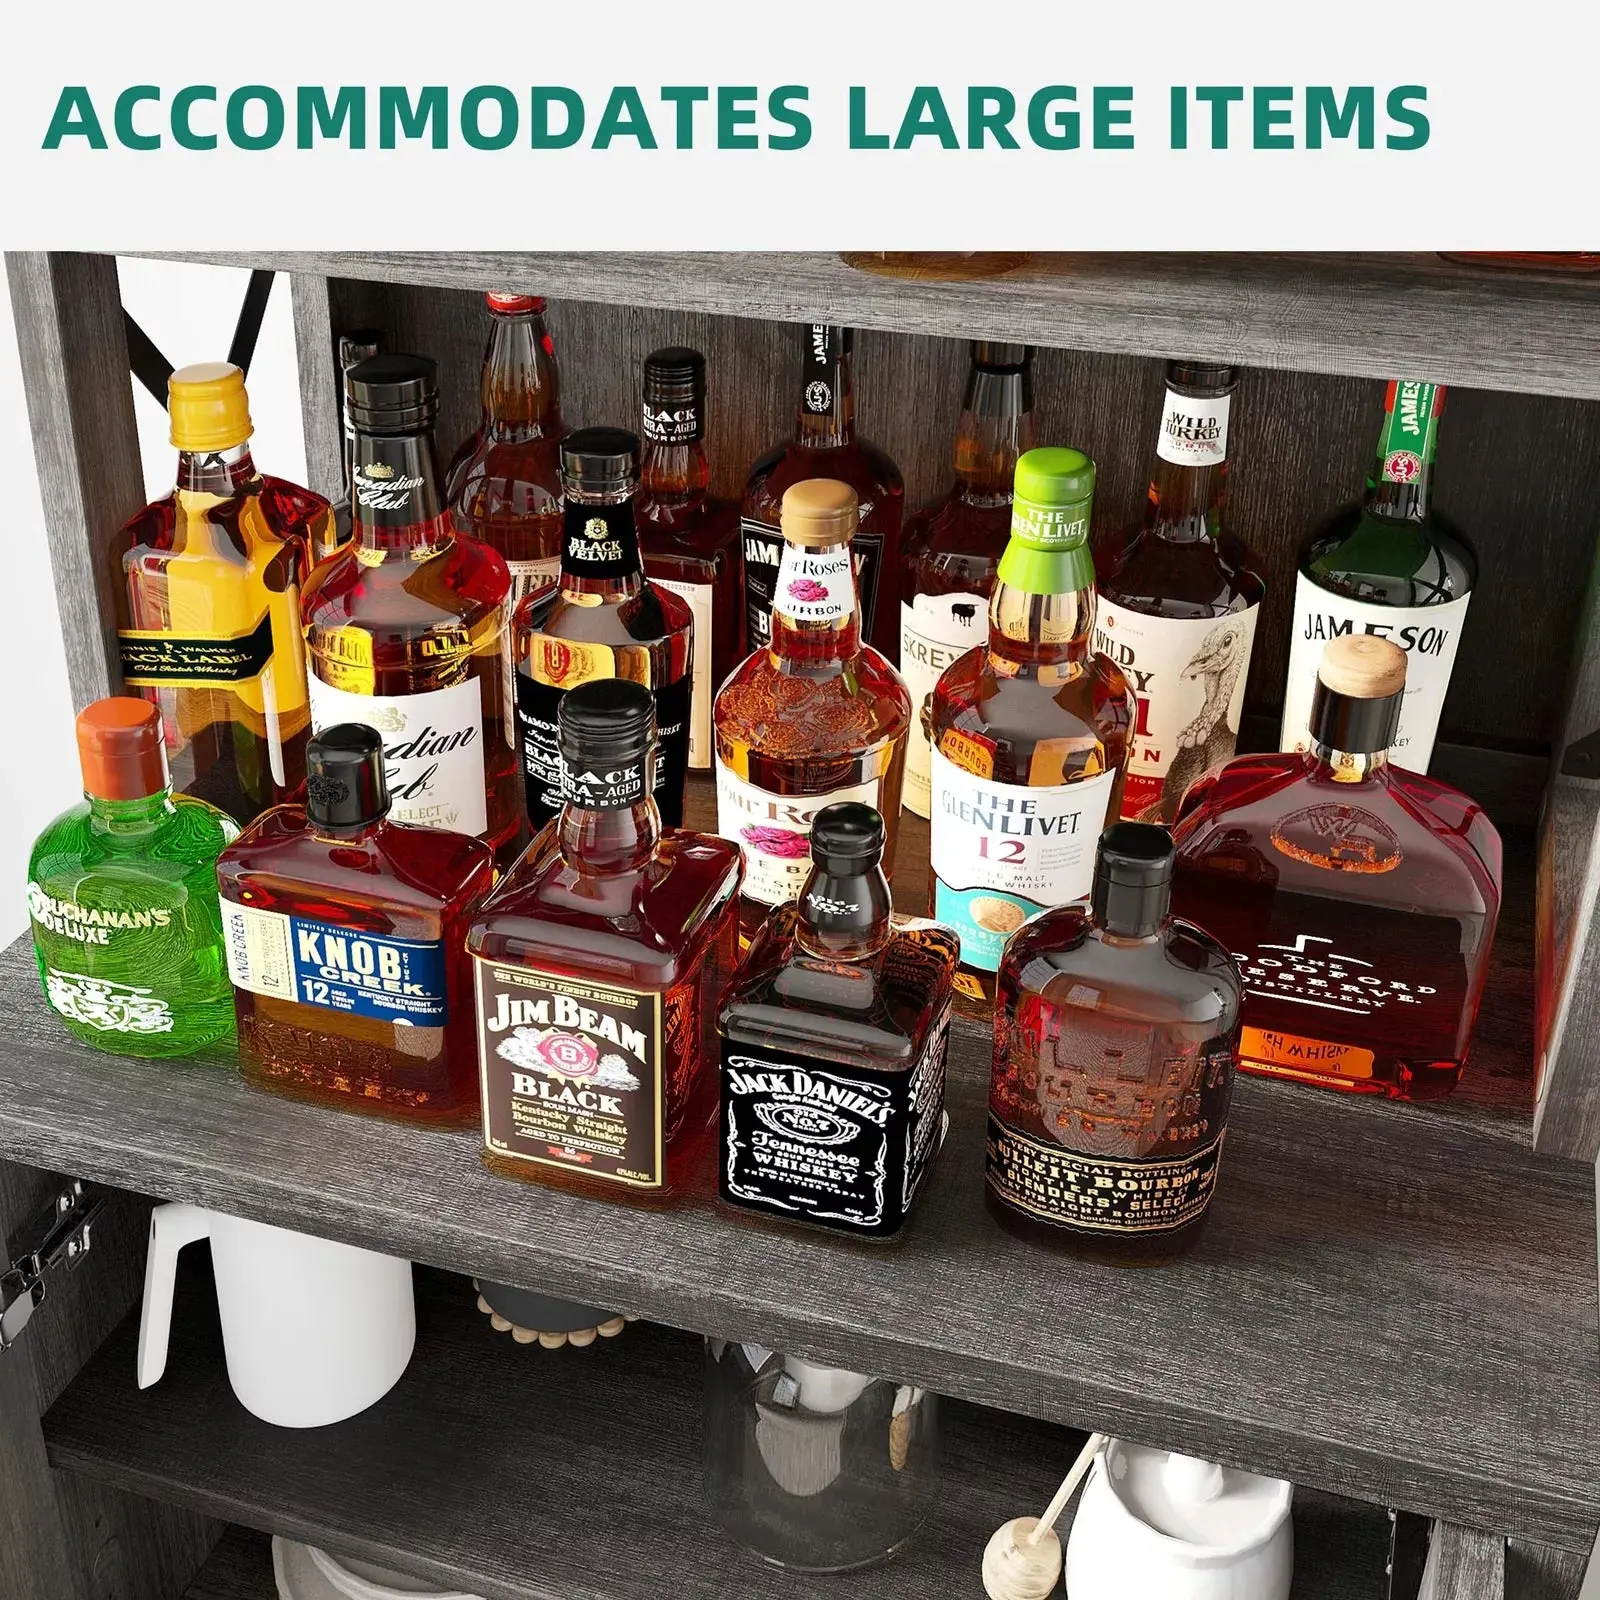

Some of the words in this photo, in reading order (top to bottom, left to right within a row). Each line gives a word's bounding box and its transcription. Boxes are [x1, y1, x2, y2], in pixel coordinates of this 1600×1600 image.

[643, 402, 696, 422] LACK
[1172, 411, 1217, 428] WILD
[1165, 418, 1222, 440] TURKEY
[1028, 507, 1065, 523] THE
[568, 546, 623, 561] VELVET
[571, 537, 621, 551] BLACK
[803, 558, 849, 577] Roses
[179, 653, 252, 664] LABEL
[1095, 627, 1136, 666] WILD
[560, 760, 641, 785] LACK
[605, 778, 641, 798] AGED
[942, 790, 1082, 836] GLENLIVET
[973, 788, 1037, 815] THE
[979, 836, 1026, 865] 12
[44, 912, 110, 945] DELUXE
[298, 929, 402, 980] KNOB
[1283, 953, 1343, 971] THE
[262, 974, 279, 988] 12
[302, 980, 330, 1005] 12
[319, 966, 428, 997] CREEK
[358, 990, 394, 1003] KENTUCKY
[396, 997, 432, 1008] STRAIGHT
[407, 1006, 443, 1014] WHISKEY
[488, 994, 550, 1032] JIM
[552, 994, 648, 1064] BEAM
[511, 1072, 625, 1116] BLACK
[727, 1069, 792, 1095] JACK
[793, 1071, 896, 1125] DANIEL'S
[511, 1101, 570, 1123] Kentucky
[576, 1116, 628, 1135] Straight
[512, 1111, 567, 1131] Bourbon
[573, 1124, 627, 1146] Whiskey
[753, 1151, 858, 1183] WHISKEY
[1011, 1140, 1037, 1158] VERY
[1040, 1154, 1114, 1176] SPECIAL
[1121, 1166, 1187, 1179] BOTTLING
[1003, 1158, 1099, 1197] FRONTIER
[1112, 1185, 1189, 1200] WHISKEY
[1007, 1168, 1119, 1208] BLENDERS'
[1130, 1193, 1187, 1211] SELECT
[1094, 1168, 1200, 1191] BOURBON
[827, 1186, 865, 1199] TODAY
[1025, 1189, 1104, 1215] STRAIGHT
[1113, 1208, 1177, 1218] BOURBON
[1080, 1213, 1121, 1224] bourbon
